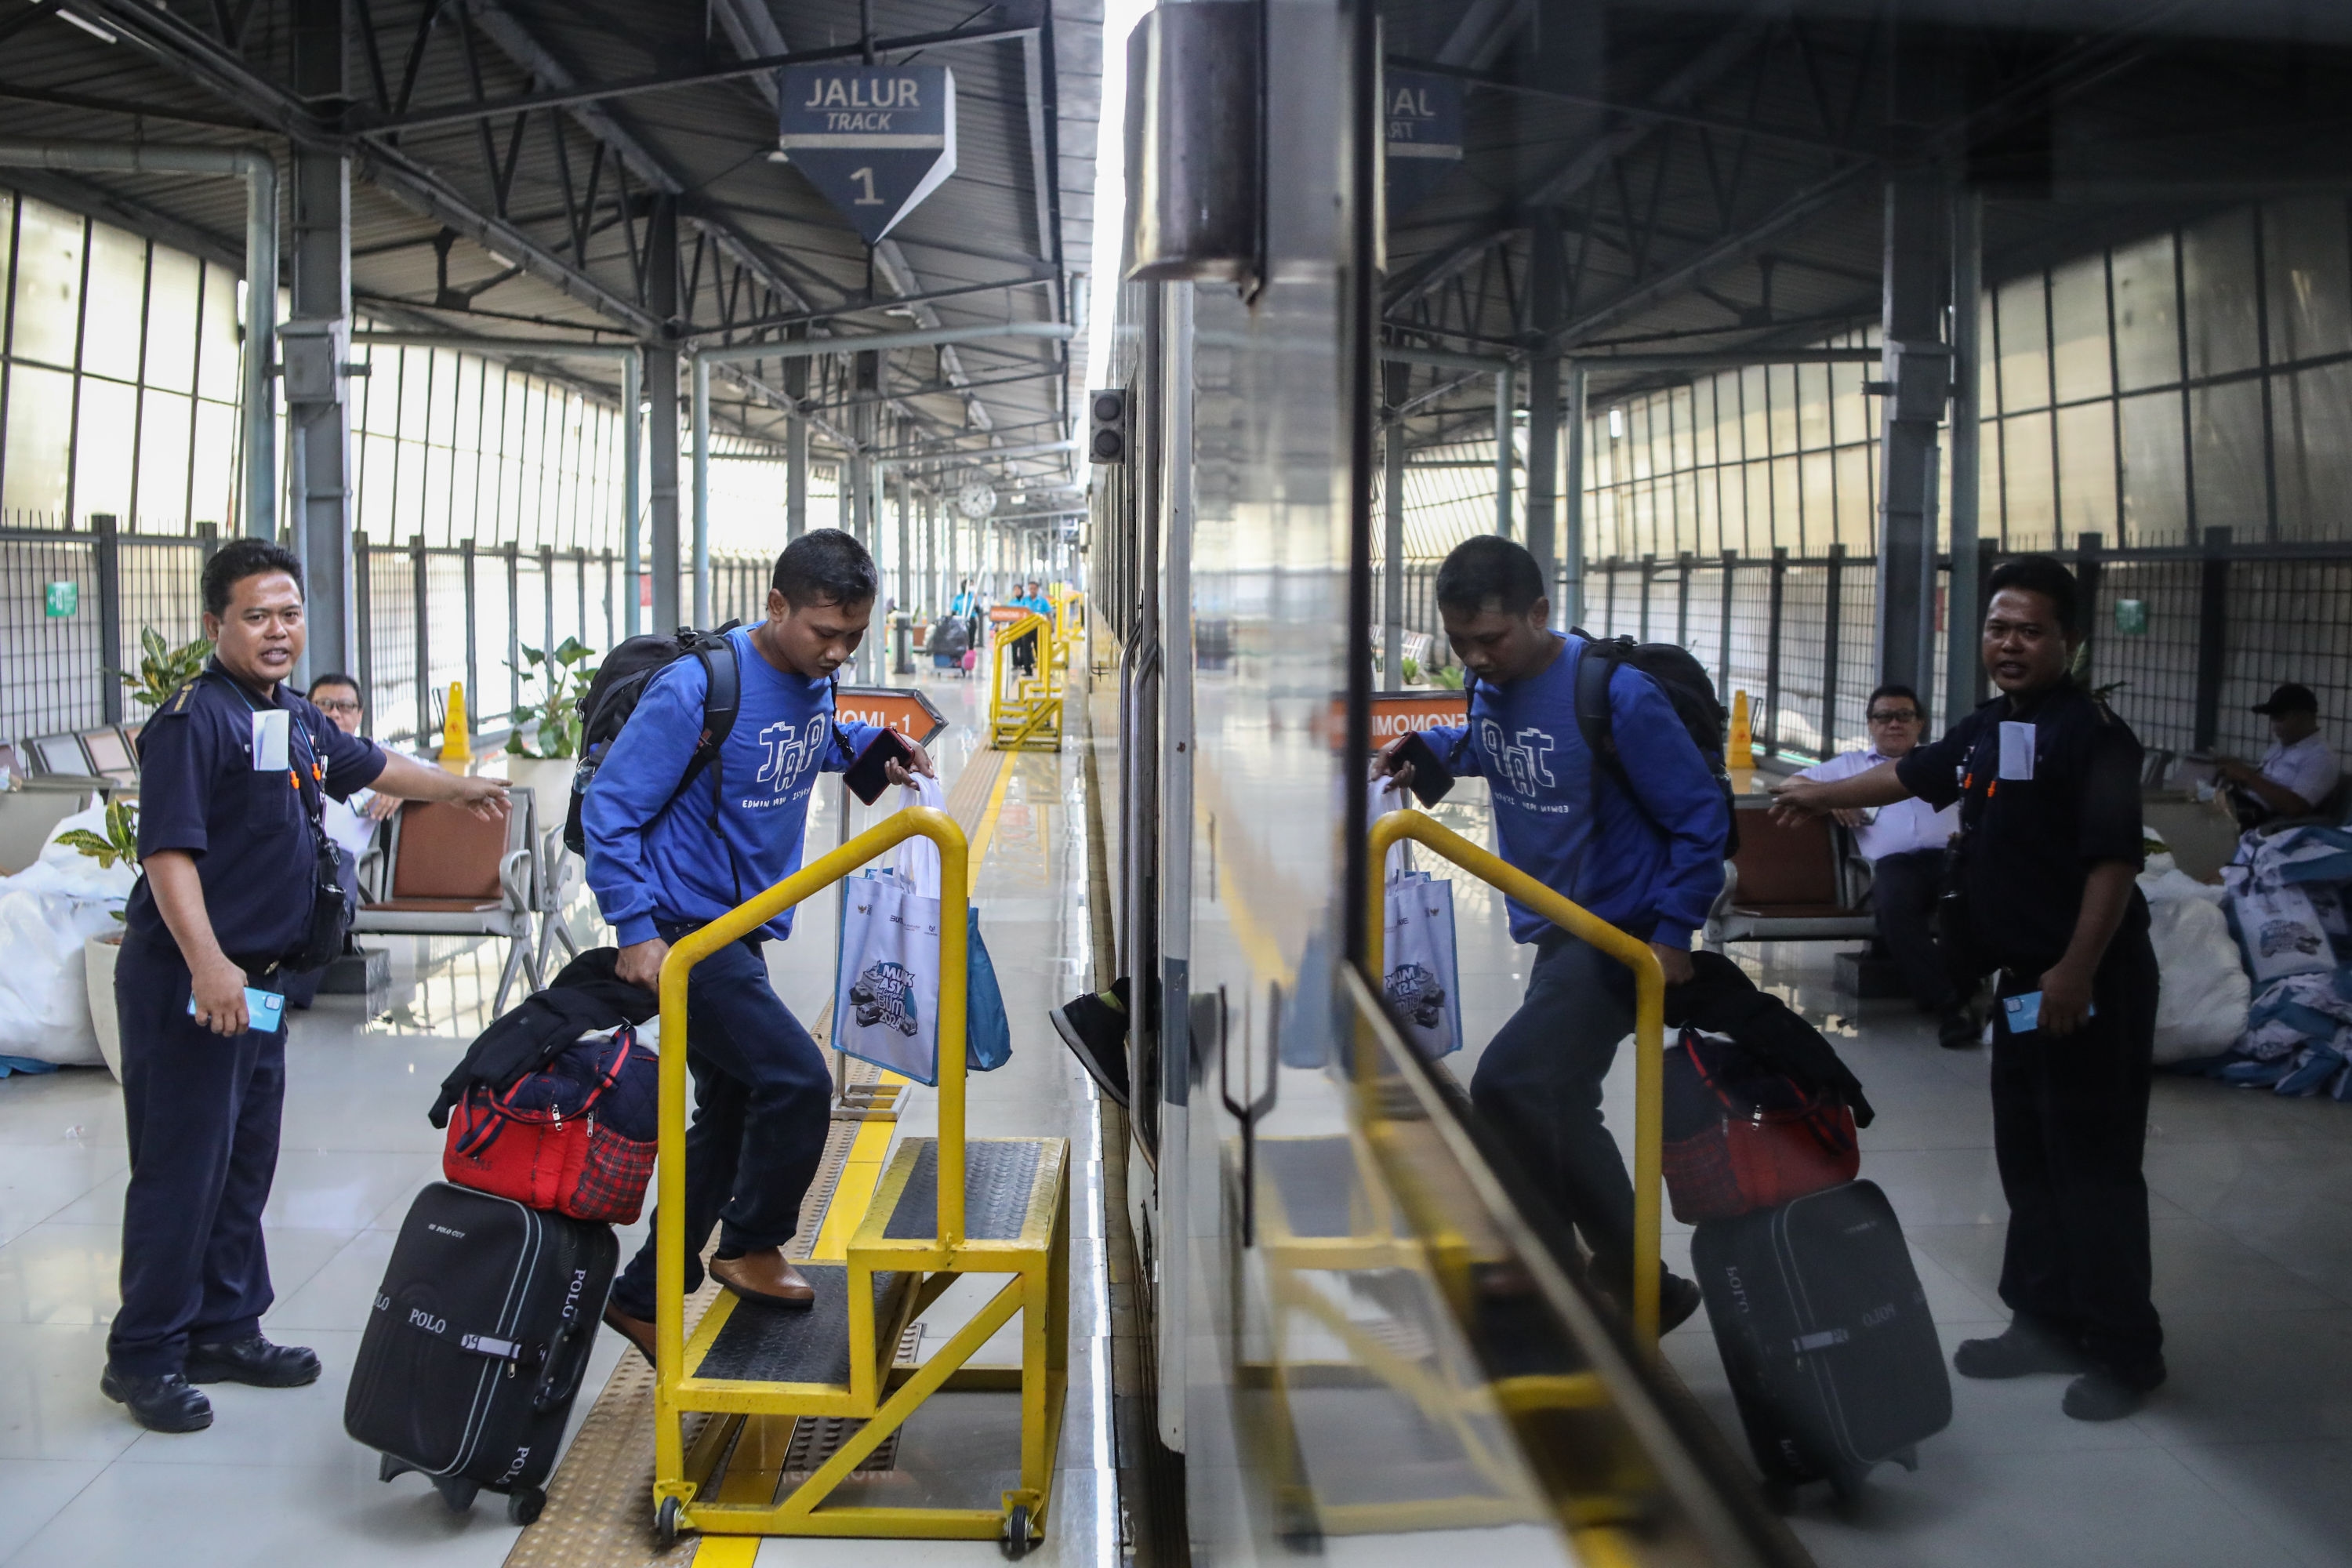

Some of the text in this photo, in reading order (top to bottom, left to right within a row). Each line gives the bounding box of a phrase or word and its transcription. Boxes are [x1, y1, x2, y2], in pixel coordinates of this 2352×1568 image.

[805, 78, 920, 107] JALUR
[827, 112, 892, 131] TRACK
[850, 167, 885, 205] 1
[742, 799, 770, 808] EDWIN
[408, 1308, 447, 1334] POLO
